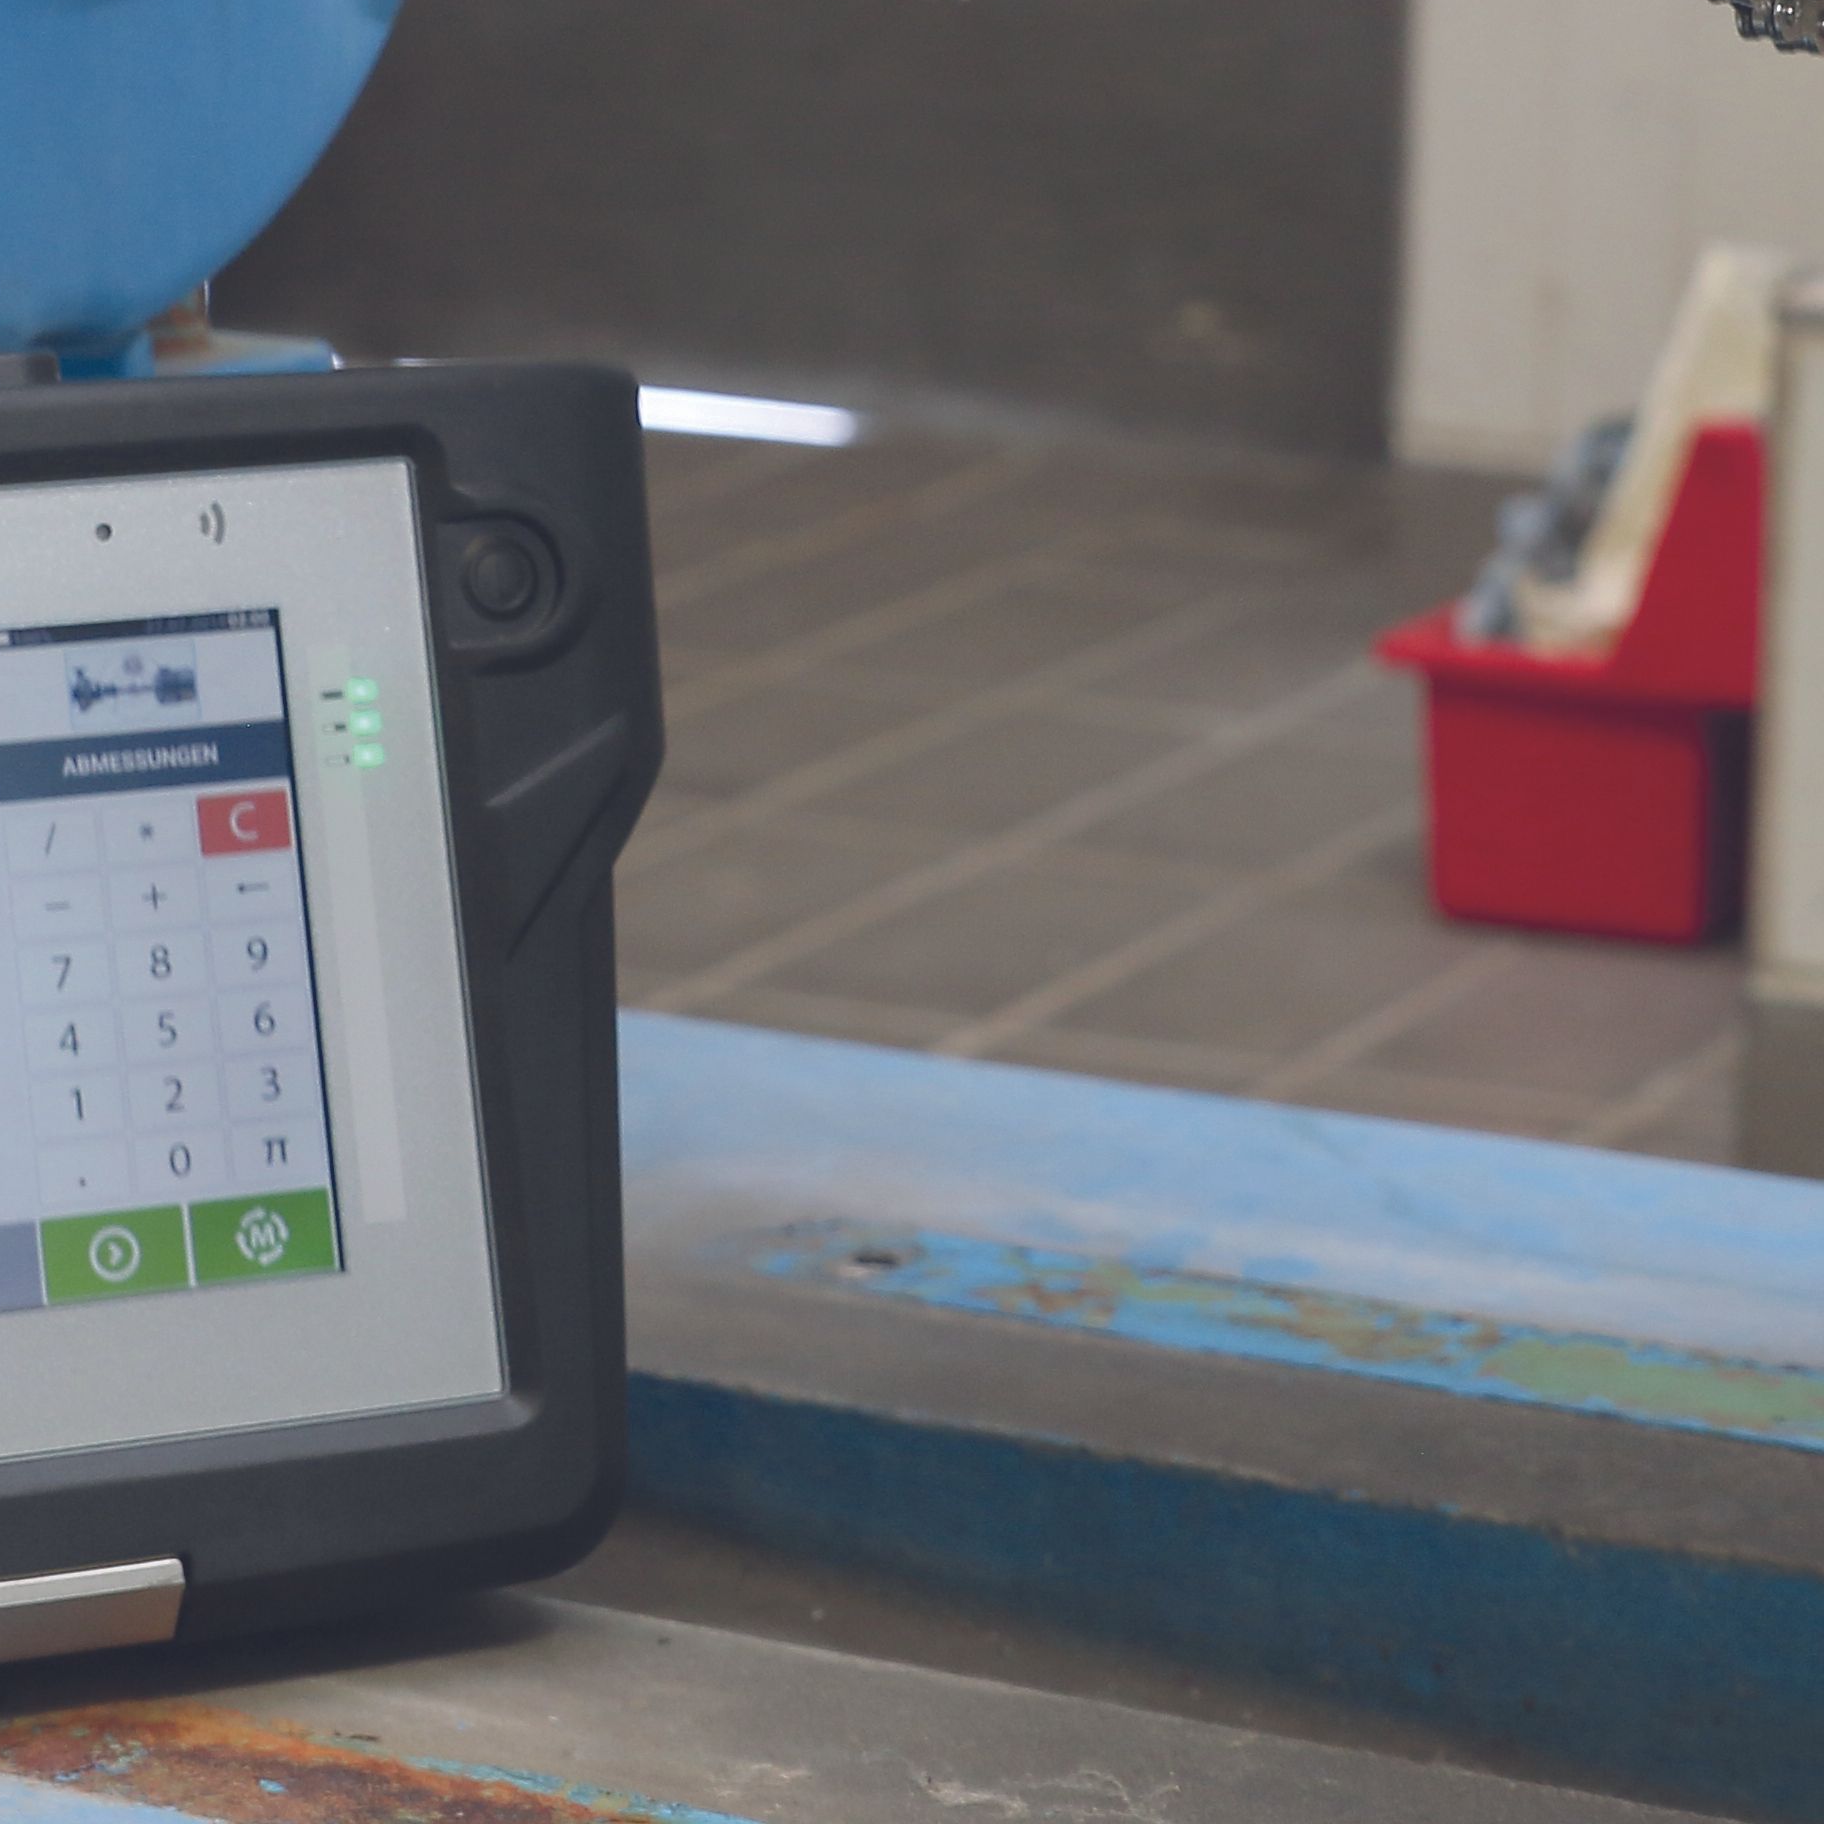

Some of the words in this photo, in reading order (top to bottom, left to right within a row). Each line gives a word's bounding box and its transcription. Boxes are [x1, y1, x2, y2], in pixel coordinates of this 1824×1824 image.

[62, 741, 218, 777] ABMESSUNGEN
[228, 801, 259, 842] C
[150, 945, 172, 977] 8
[246, 937, 269, 971] 9
[51, 955, 72, 991] 7
[159, 1012, 178, 1047] 5
[254, 1001, 276, 1035] 6
[59, 1022, 80, 1057] 4
[164, 1078, 184, 1113] 2
[261, 1068, 281, 1102] 3
[71, 1087, 85, 1121] 1
[168, 1144, 191, 1177] 0
